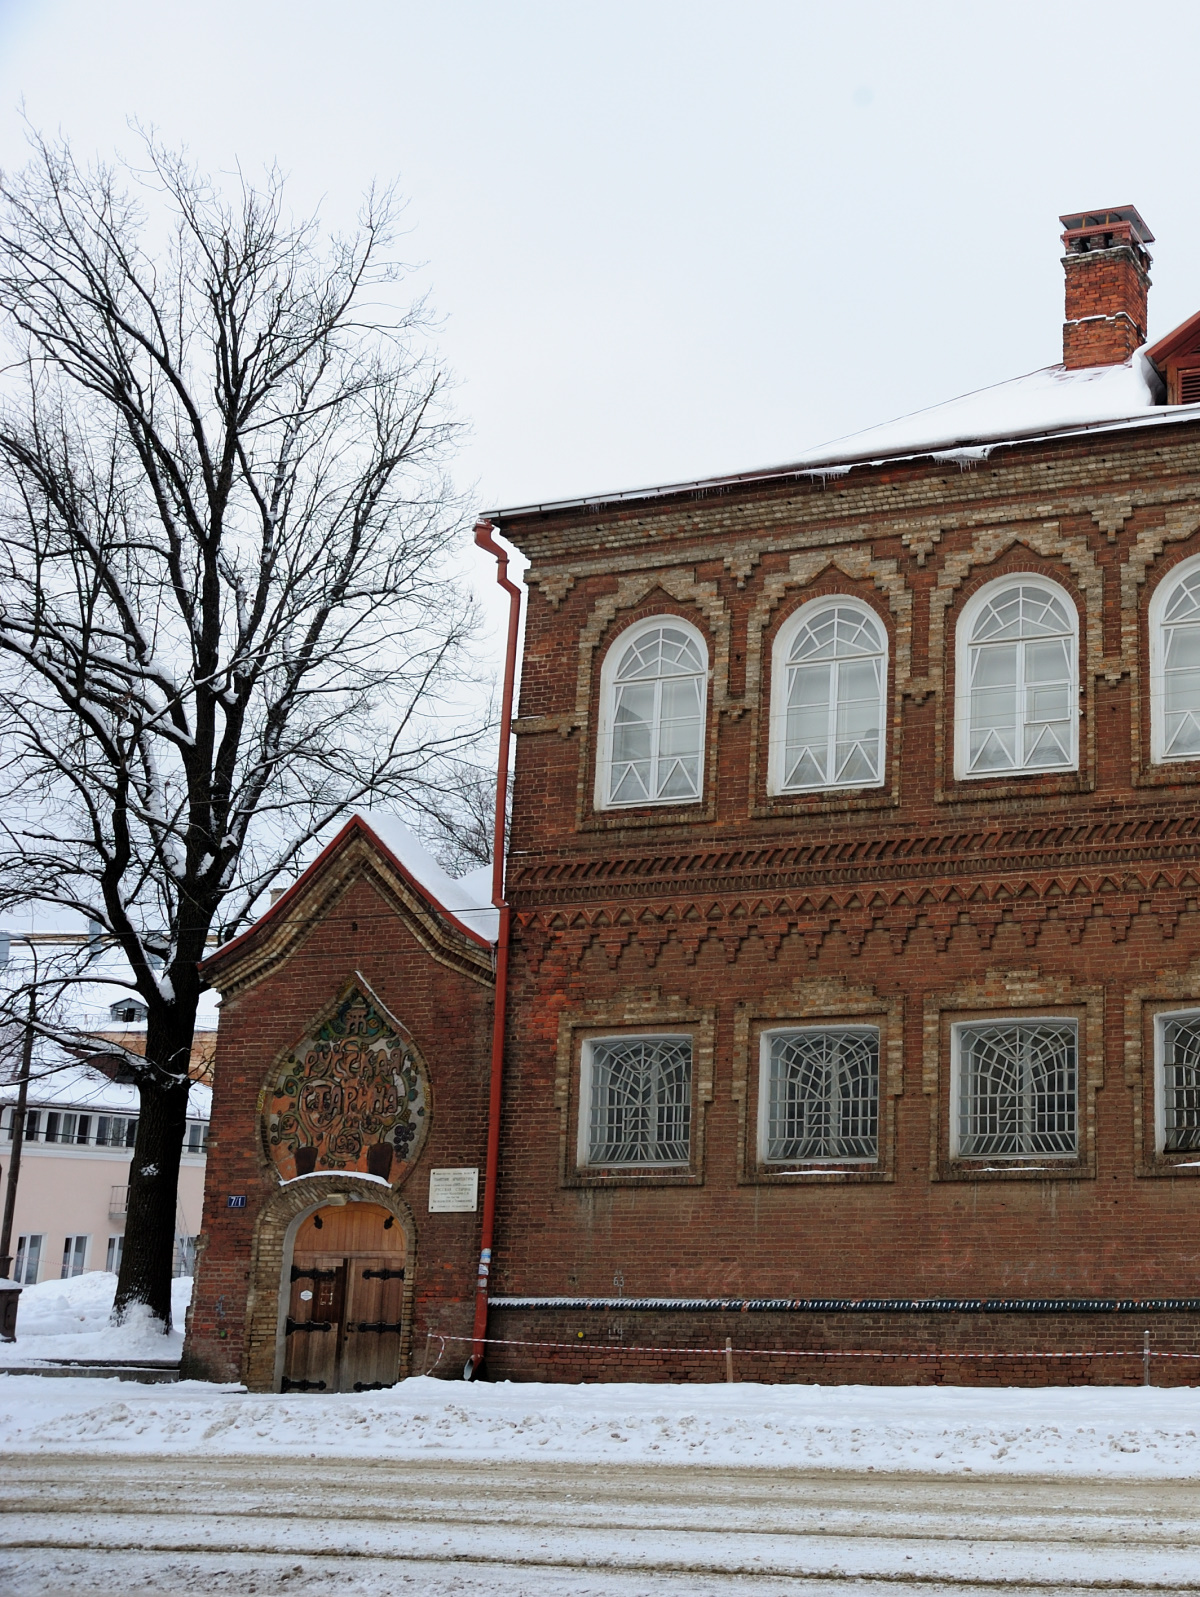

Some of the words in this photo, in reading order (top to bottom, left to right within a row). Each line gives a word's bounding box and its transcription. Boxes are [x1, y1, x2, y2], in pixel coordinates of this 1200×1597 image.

[304, 1049, 403, 1080] РУССКАЯ
[301, 1084, 398, 1116] СТАРИНА
[230, 1196, 242, 1206] 7/1
